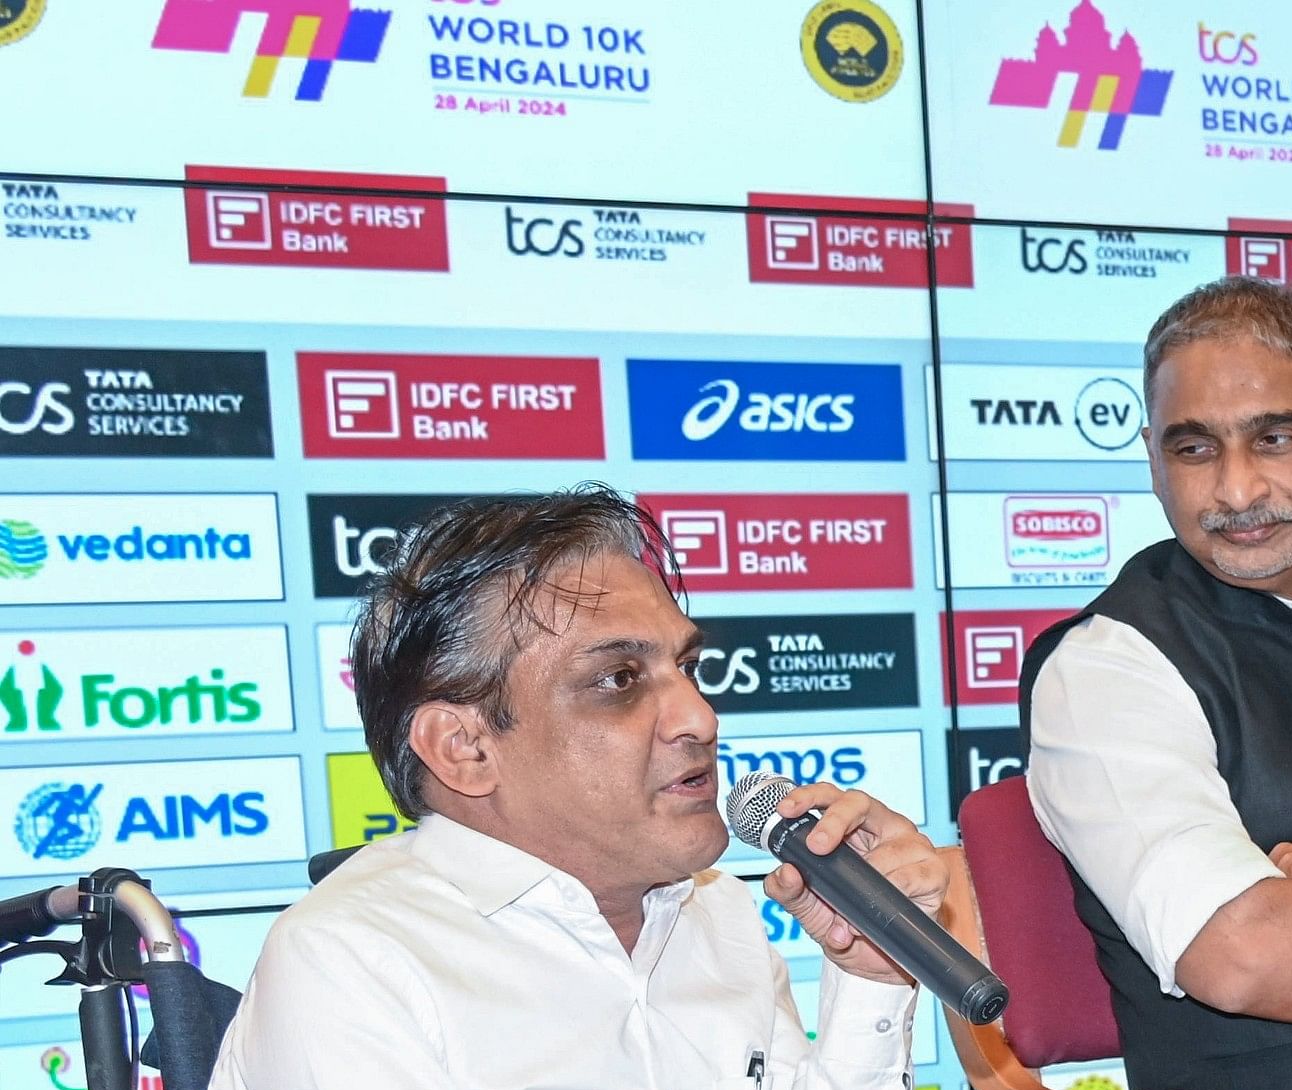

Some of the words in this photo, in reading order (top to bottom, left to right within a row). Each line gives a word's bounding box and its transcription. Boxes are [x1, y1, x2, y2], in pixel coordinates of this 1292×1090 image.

[428, 15, 569, 49] WORLD
[582, 26, 646, 55] 10K
[1197, 21, 1259, 66] tcs
[430, 54, 650, 91] BENGALURU
[435, 94, 457, 110] 28
[464, 97, 511, 114] April
[518, 99, 567, 116] 2024
[1205, 143, 1223, 158] 28
[2, 183, 59, 200] TATA
[3, 204, 137, 224] CONSULTANCY
[281, 201, 342, 227] IDFC
[350, 206, 425, 229] FIRST
[594, 210, 642, 224] TATA
[4, 223, 91, 241] SERVICES
[282, 229, 350, 254] Bank
[506, 207, 585, 258] tcs
[594, 226, 706, 246] CONSULTANCY
[827, 226, 880, 248] IDFC
[886, 228, 953, 250] FIRST
[594, 246, 667, 262] SERVICES
[827, 250, 884, 274] Bank
[1021, 229, 1088, 276] tcs
[1096, 246, 1190, 265] CONSULTANCY
[1096, 262, 1157, 278] SERVICES
[85, 369, 153, 390] TATA
[0, 382, 74, 437] cs
[86, 391, 243, 415] CONSULTANCY
[410, 382, 482, 410] IDFC
[492, 384, 577, 412] FIRST
[739, 392, 856, 433] asics
[971, 399, 1063, 426] TATA
[87, 413, 190, 438] SERVICES
[412, 413, 489, 441] Bank
[737, 520, 802, 545] IDFC
[810, 518, 887, 544] FIRST
[1014, 515, 1097, 534] SOBISCO
[59, 525, 252, 562] vedanta
[334, 515, 400, 577] tc
[739, 551, 808, 576] Bank
[768, 634, 824, 652] TATA
[697, 648, 760, 694] cs
[769, 652, 896, 672] CONSULTANCY
[770, 674, 851, 693] SERVICES
[82, 669, 261, 729] Fortis
[117, 791, 270, 842] AIMS
